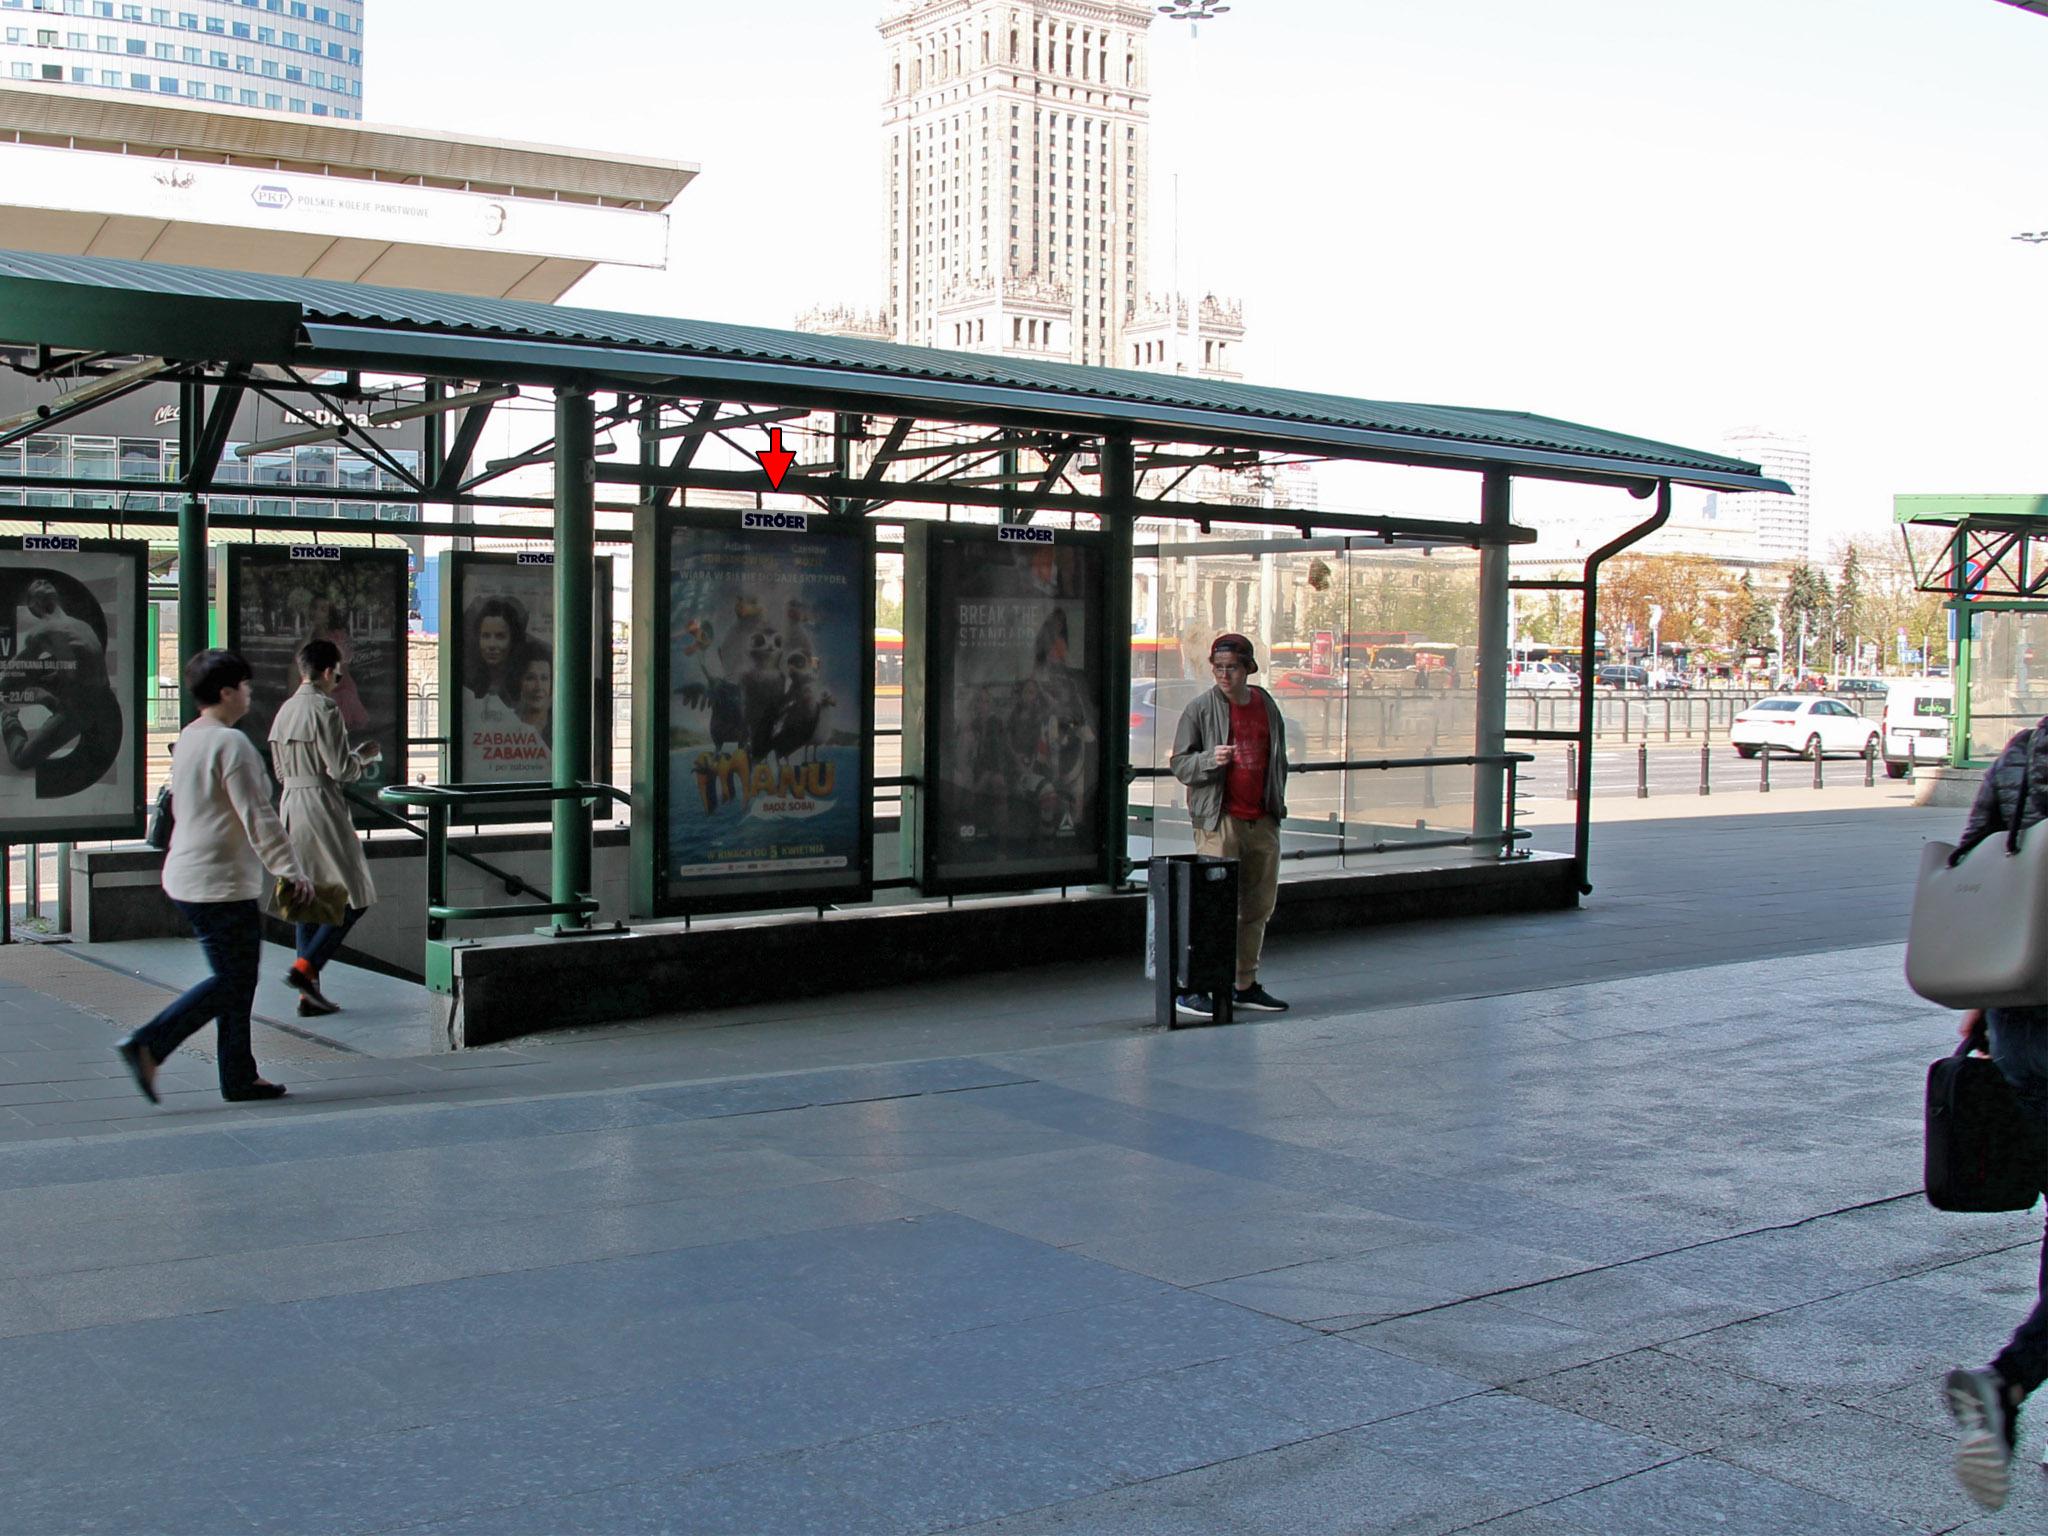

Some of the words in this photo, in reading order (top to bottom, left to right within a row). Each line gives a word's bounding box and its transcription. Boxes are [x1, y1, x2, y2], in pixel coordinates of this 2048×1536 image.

[258, 191, 288, 203] PKP
[297, 195, 336, 208] POLSKIE
[338, 201, 371, 212] KOLEJE
[154, 405, 180, 422] McC
[284, 408, 402, 429] McDonals
[745, 513, 805, 529] STRÖER
[1000, 527, 1053, 541] STRÖER
[25, 536, 77, 549] STRÖER
[292, 546, 339, 558] STRÖER
[519, 553, 554, 563] STRÖE
[960, 605, 1006, 625] BREAK
[1012, 605, 1039, 625] THE
[960, 627, 1035, 647] STANDARD
[473, 732, 537, 745] ZABAWA
[483, 747, 547, 760] ZABAWA
[691, 748, 836, 816] MANU
